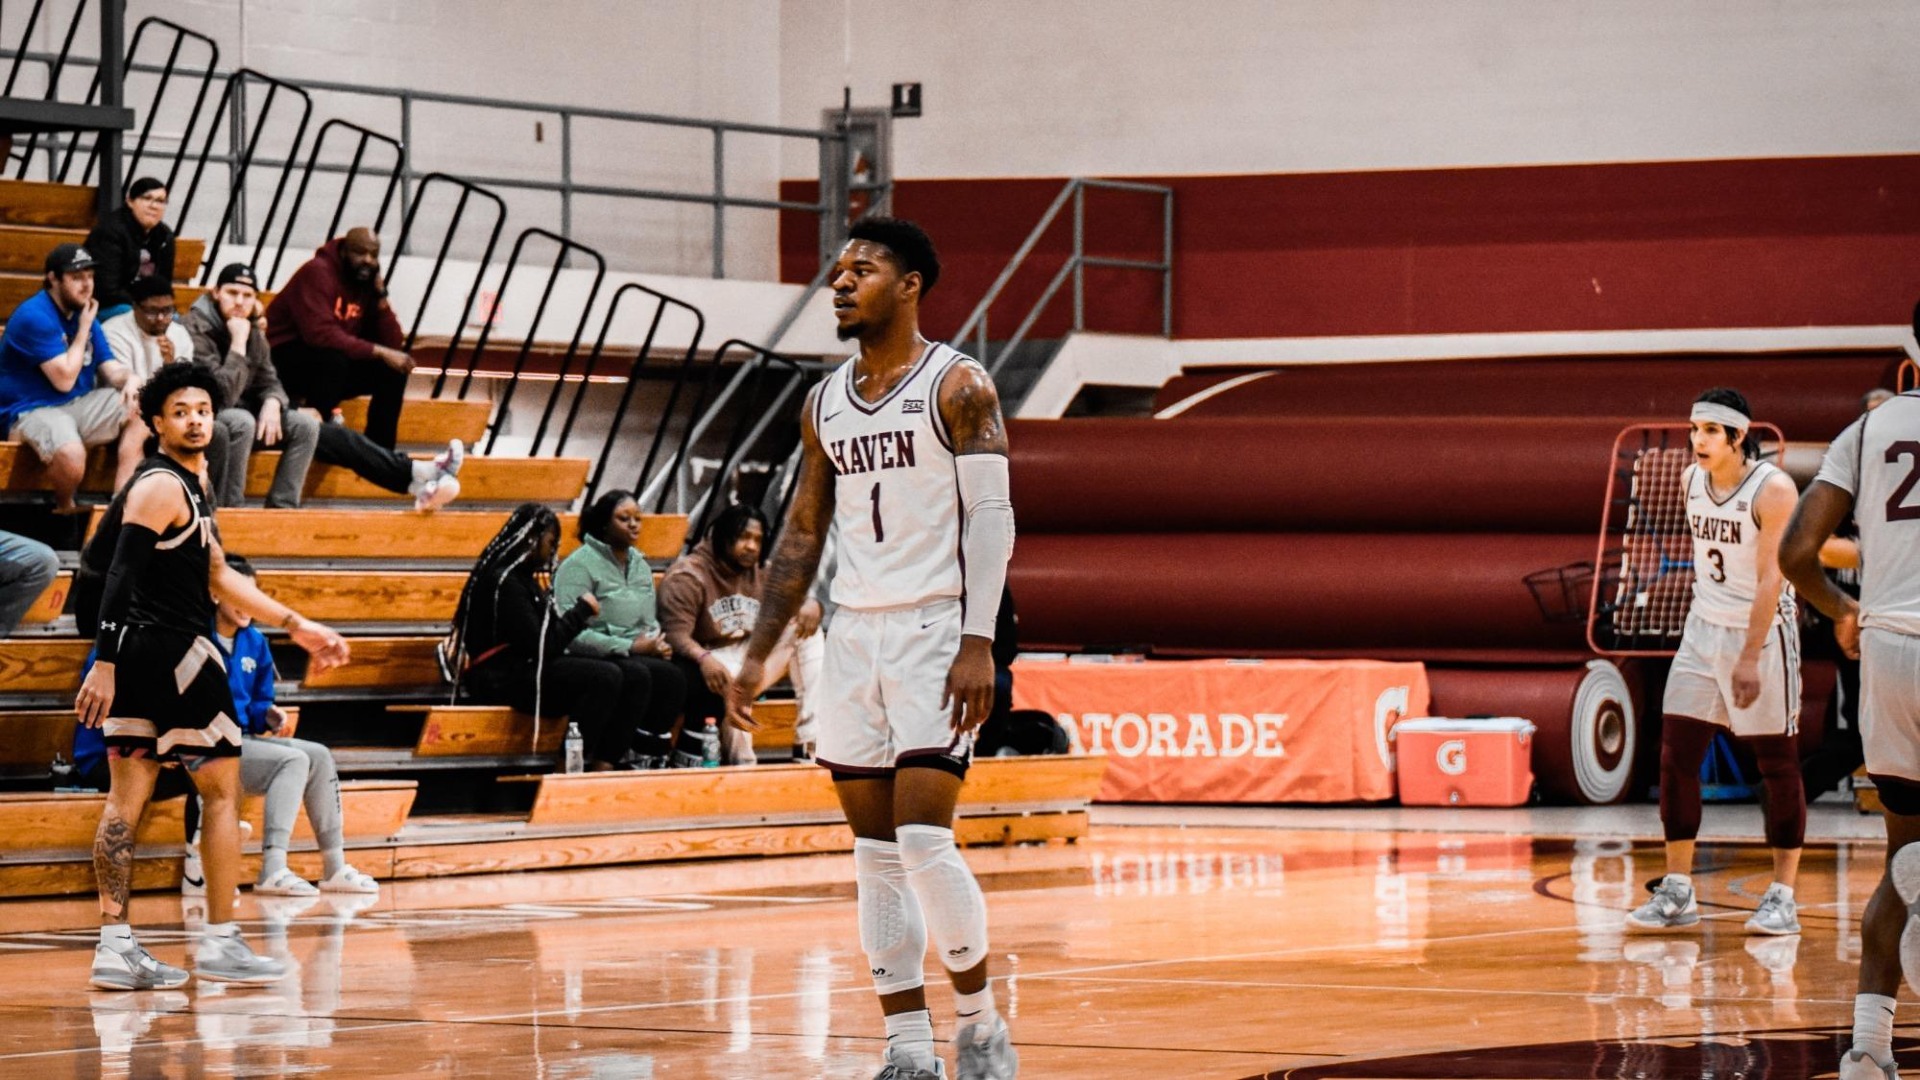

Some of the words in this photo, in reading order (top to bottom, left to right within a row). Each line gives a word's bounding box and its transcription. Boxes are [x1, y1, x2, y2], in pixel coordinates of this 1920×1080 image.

[830, 430, 916, 476] HAVEN
[1885, 441, 1920, 522] 2
[870, 481, 884, 543] 1
[1692, 515, 1742, 544] HAVEN
[1707, 548, 1726, 583] 3
[1057, 712, 1288, 757] ATORADE
[1436, 740, 1467, 775] G
